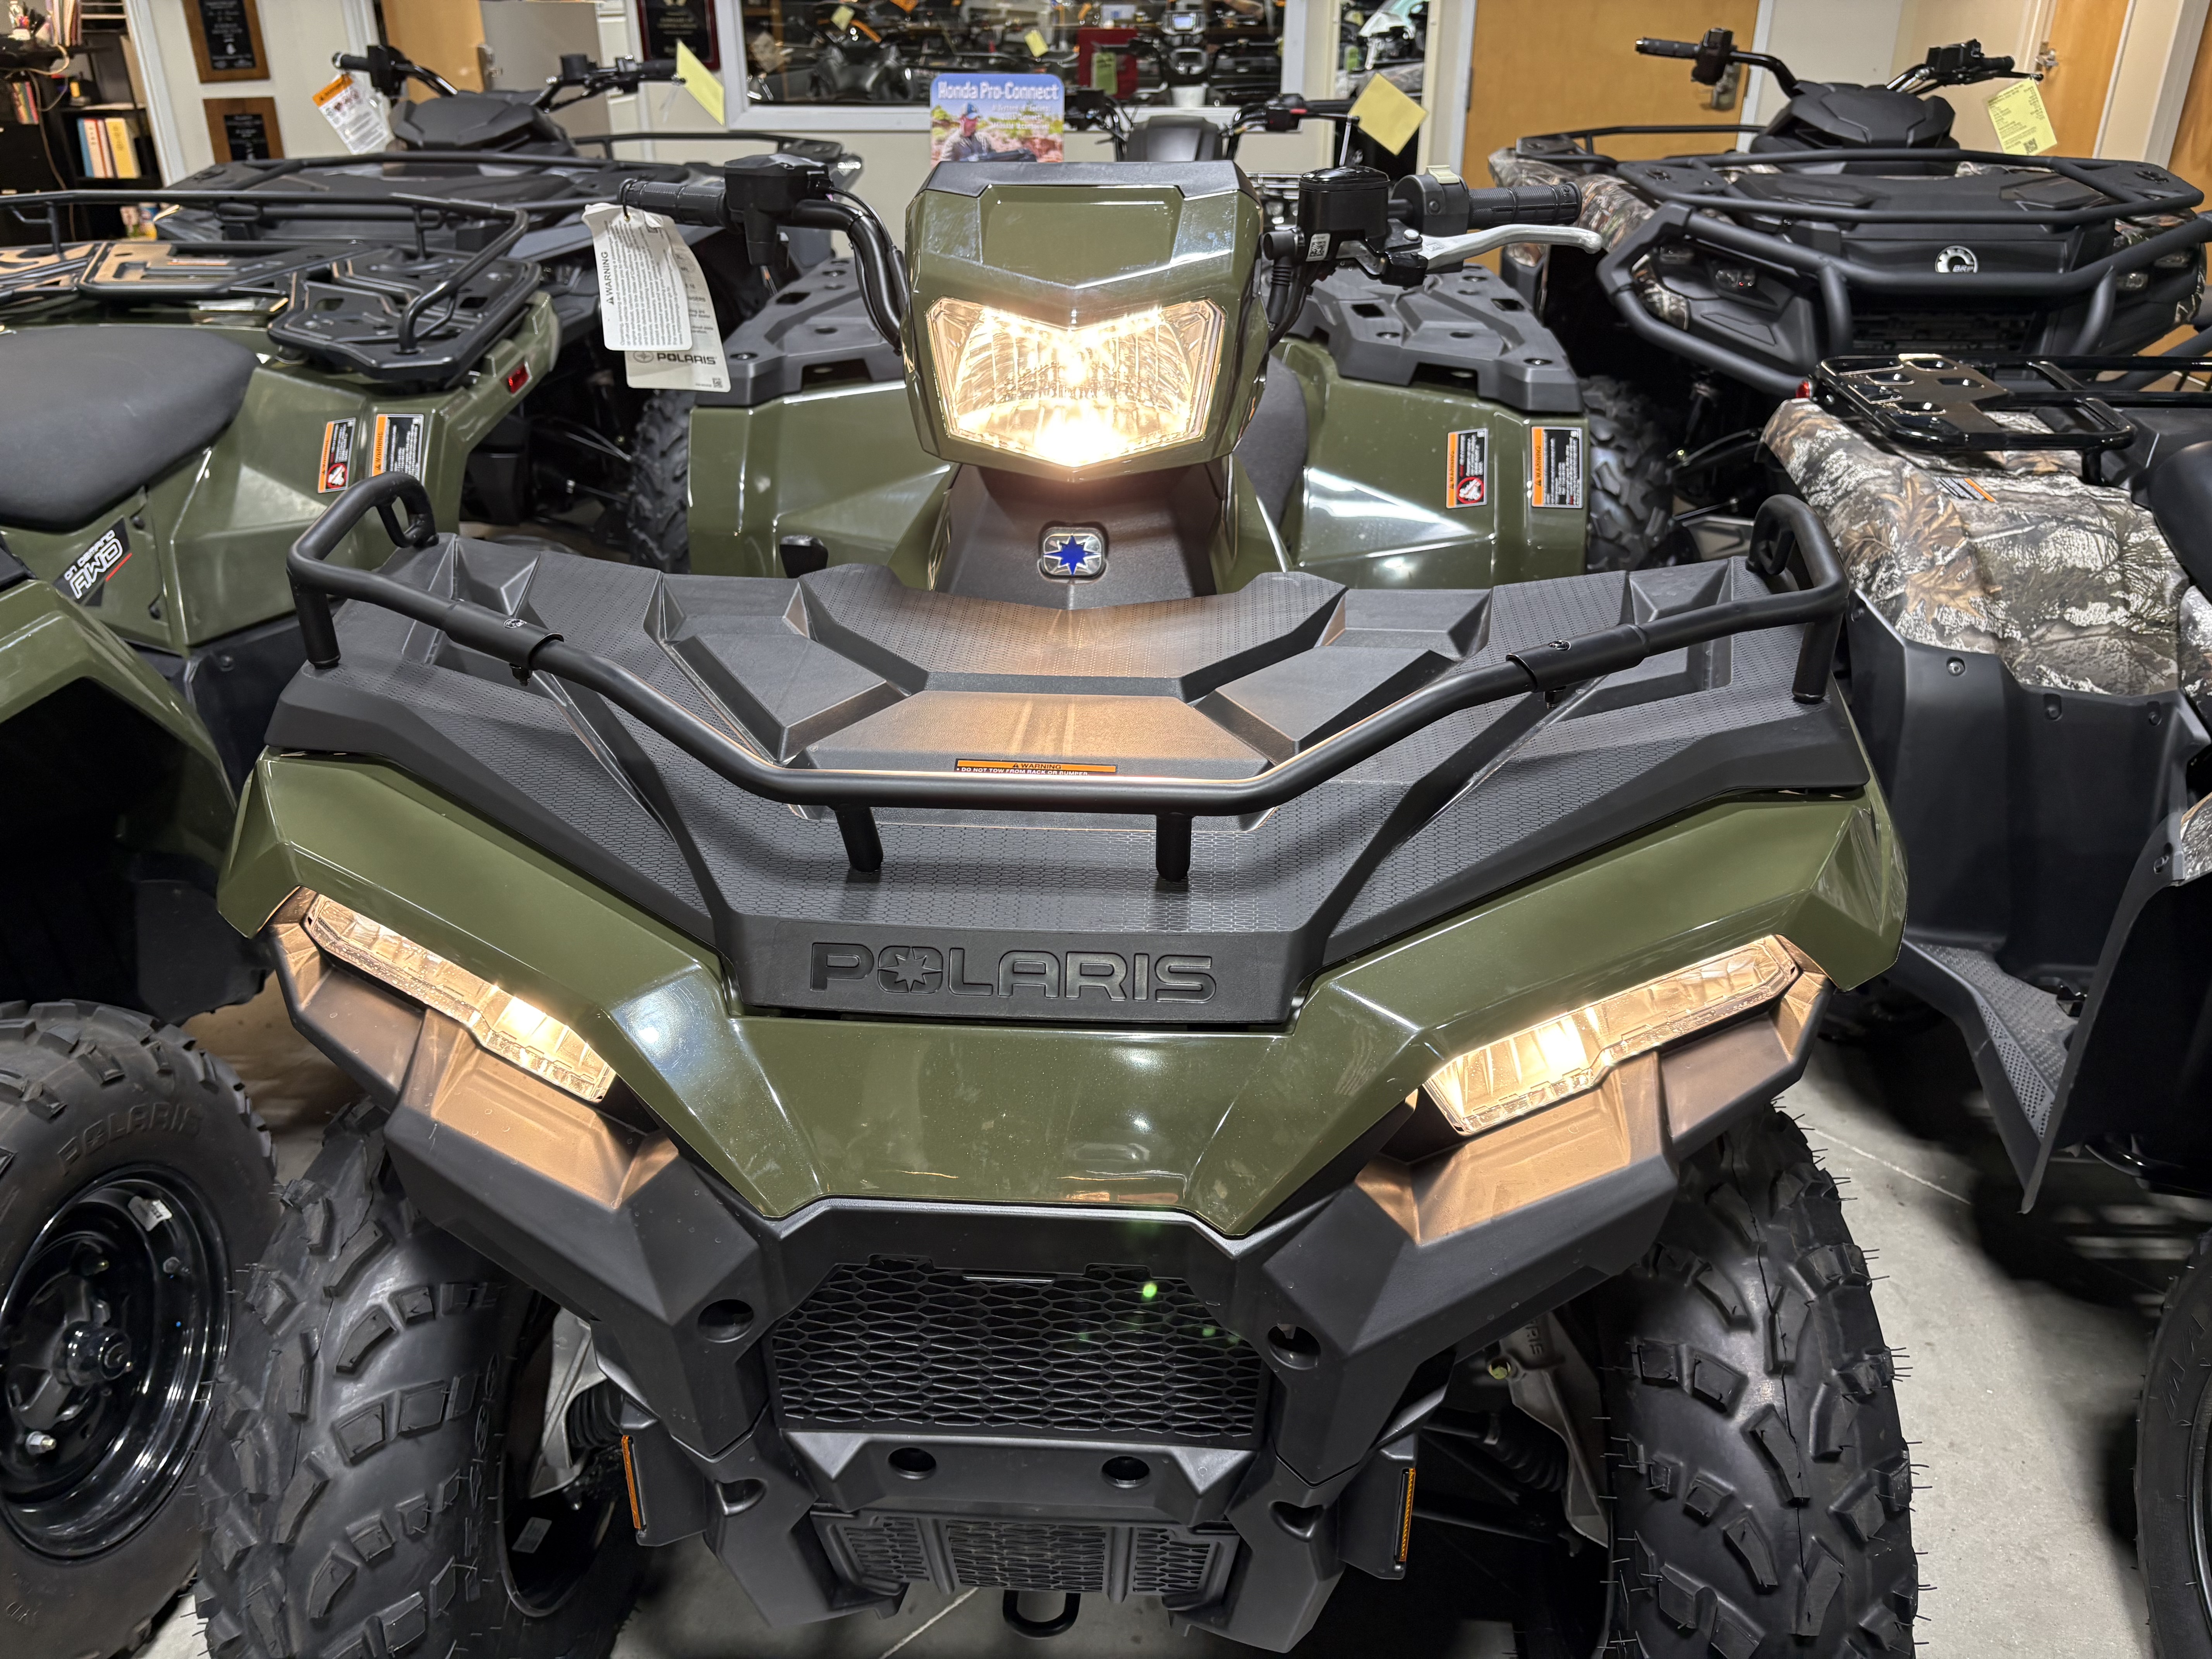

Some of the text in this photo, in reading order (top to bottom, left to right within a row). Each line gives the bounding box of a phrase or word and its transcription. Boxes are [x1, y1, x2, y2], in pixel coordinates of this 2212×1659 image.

[938, 81, 1060, 100] Honda Pro-Connect
[601, 252, 613, 296] WARNING
[657, 353, 716, 364] POLARIS
[69, 538, 123, 599] AWD
[810, 943, 1217, 1004] POLARIS
